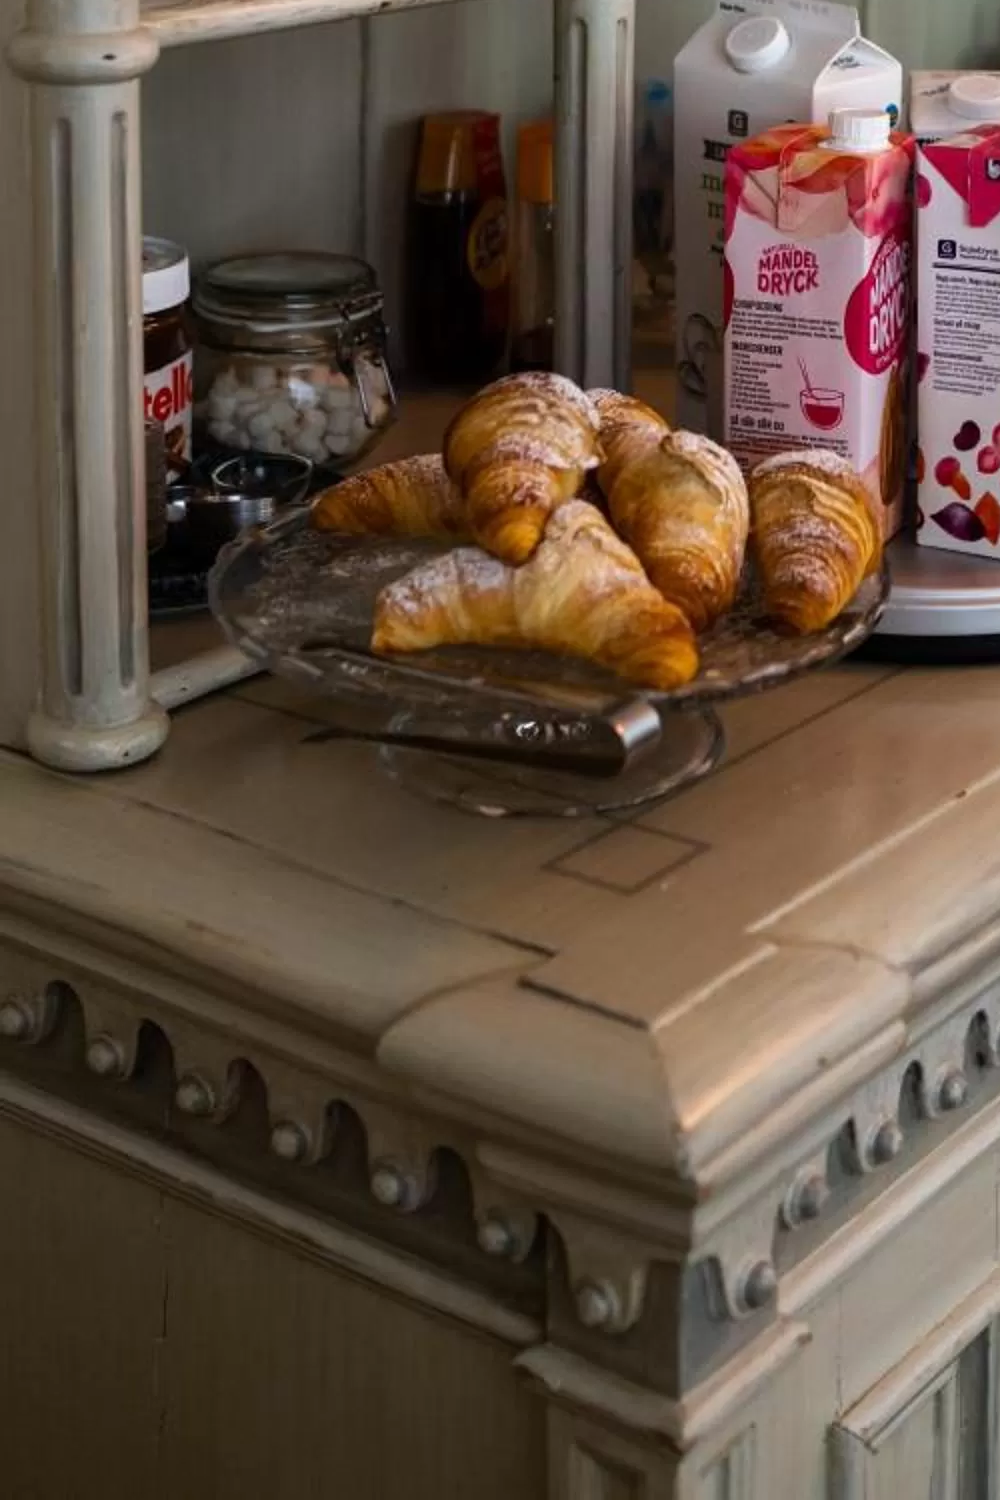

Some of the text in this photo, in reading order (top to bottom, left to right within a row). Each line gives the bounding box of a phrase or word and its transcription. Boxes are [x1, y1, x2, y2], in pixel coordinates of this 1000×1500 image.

[757, 269, 819, 296] DRYCK
[759, 250, 819, 272] MANDEL
[870, 281, 905, 355] DRYC
[144, 362, 192, 421] tell
